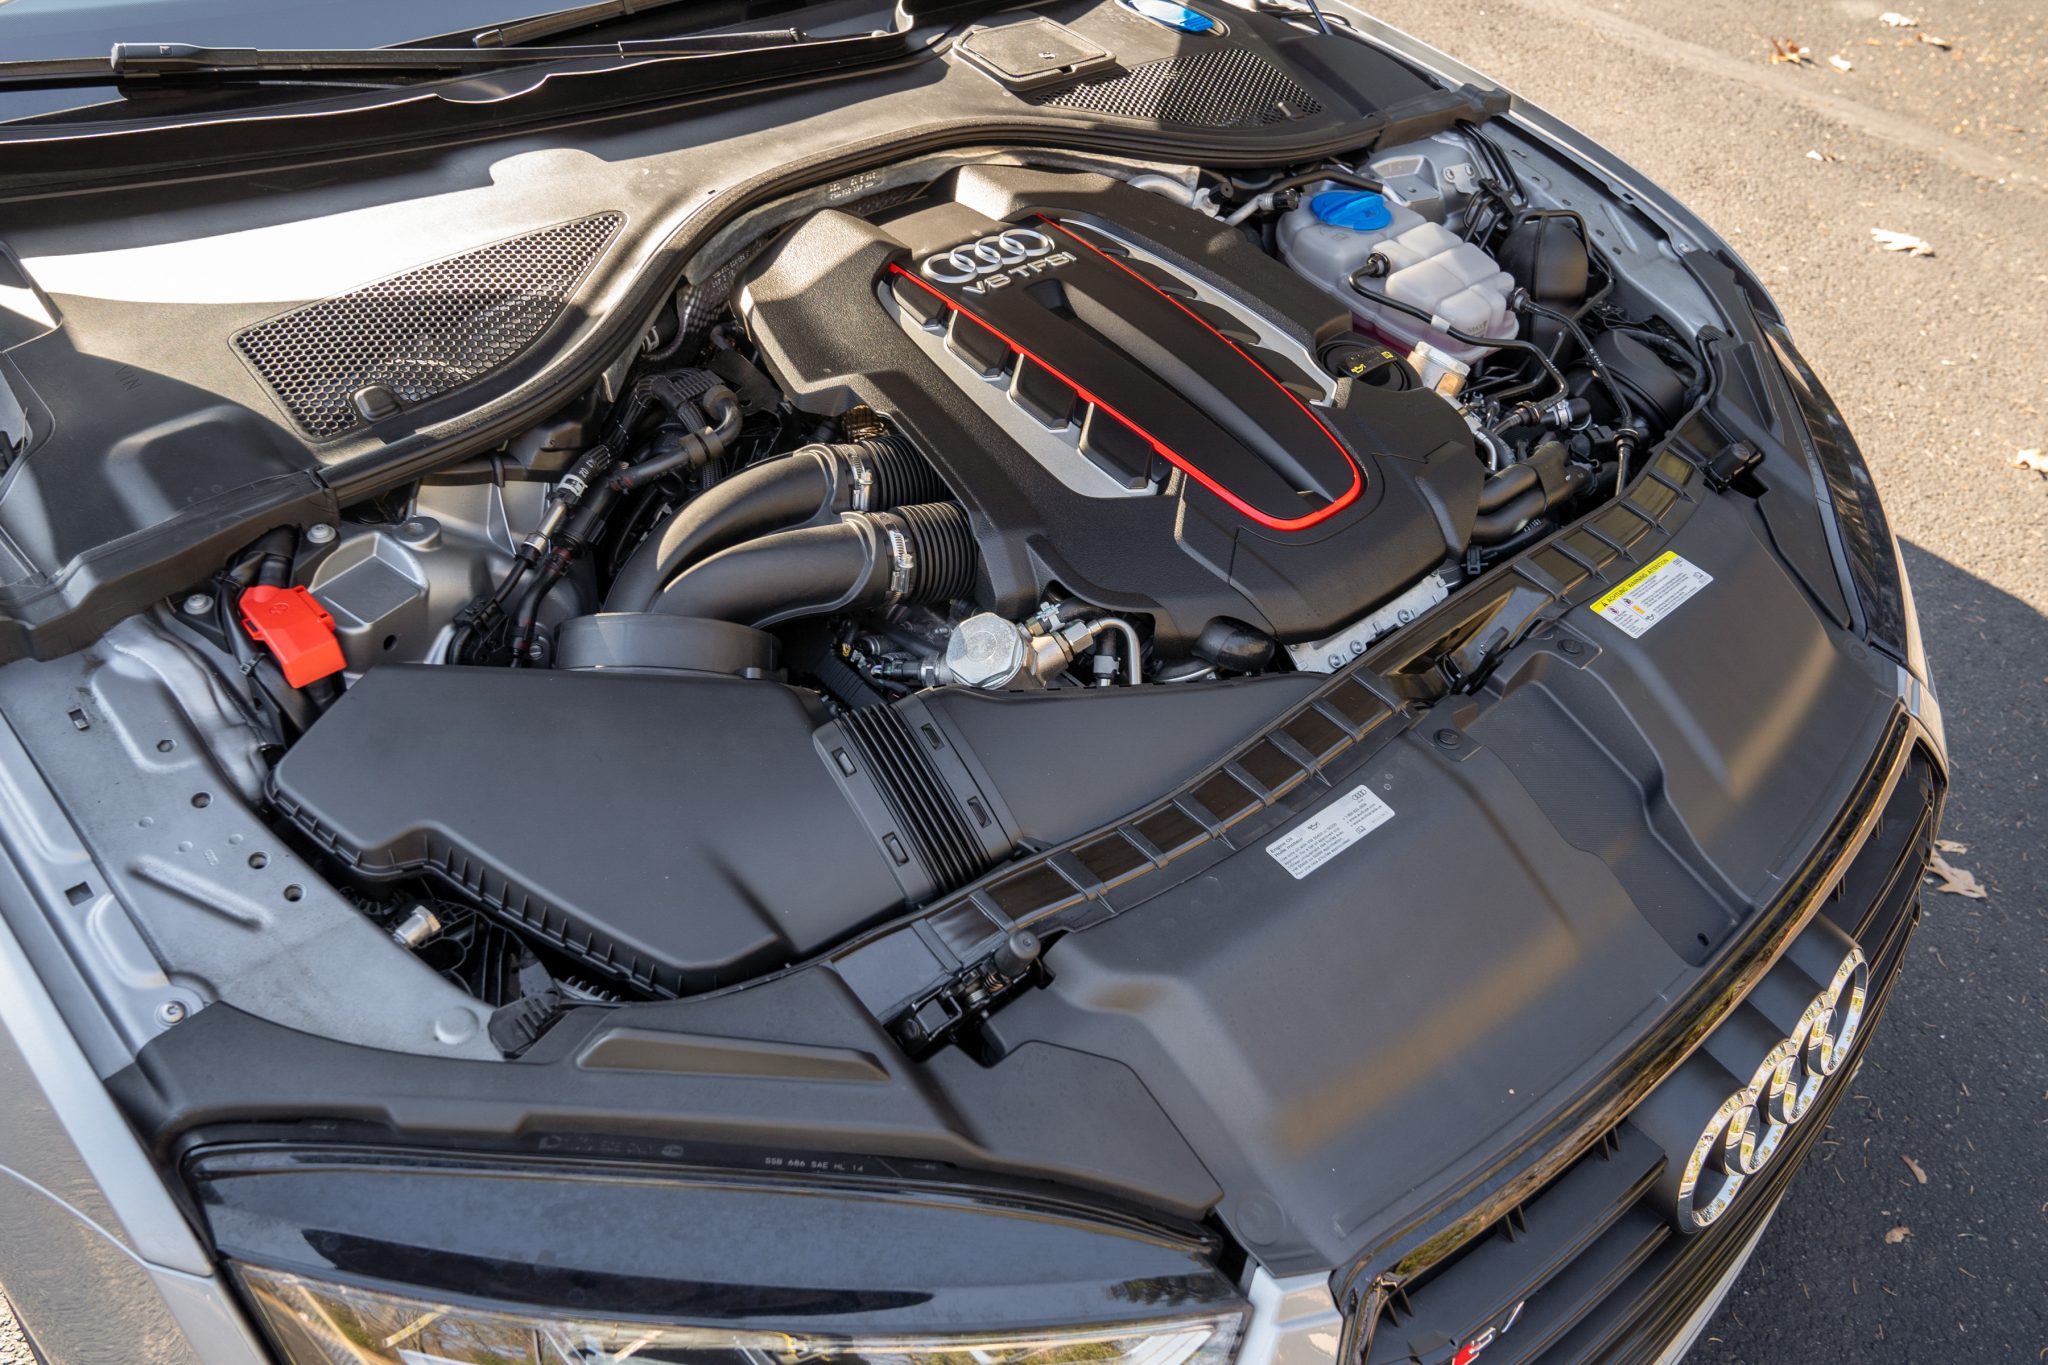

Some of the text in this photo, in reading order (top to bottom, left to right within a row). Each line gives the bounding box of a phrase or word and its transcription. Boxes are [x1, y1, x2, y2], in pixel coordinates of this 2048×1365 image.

[962, 251, 1077, 295] V8 TFSI
[1607, 587, 1628, 602] ACHTUNG
[1627, 573, 1648, 588] WARNING
[1647, 558, 1669, 574] ATTENTION
[1270, 842, 1286, 853] Engine
[1274, 838, 1303, 857] Huile moteur
[811, 1160, 829, 1169] SAE
